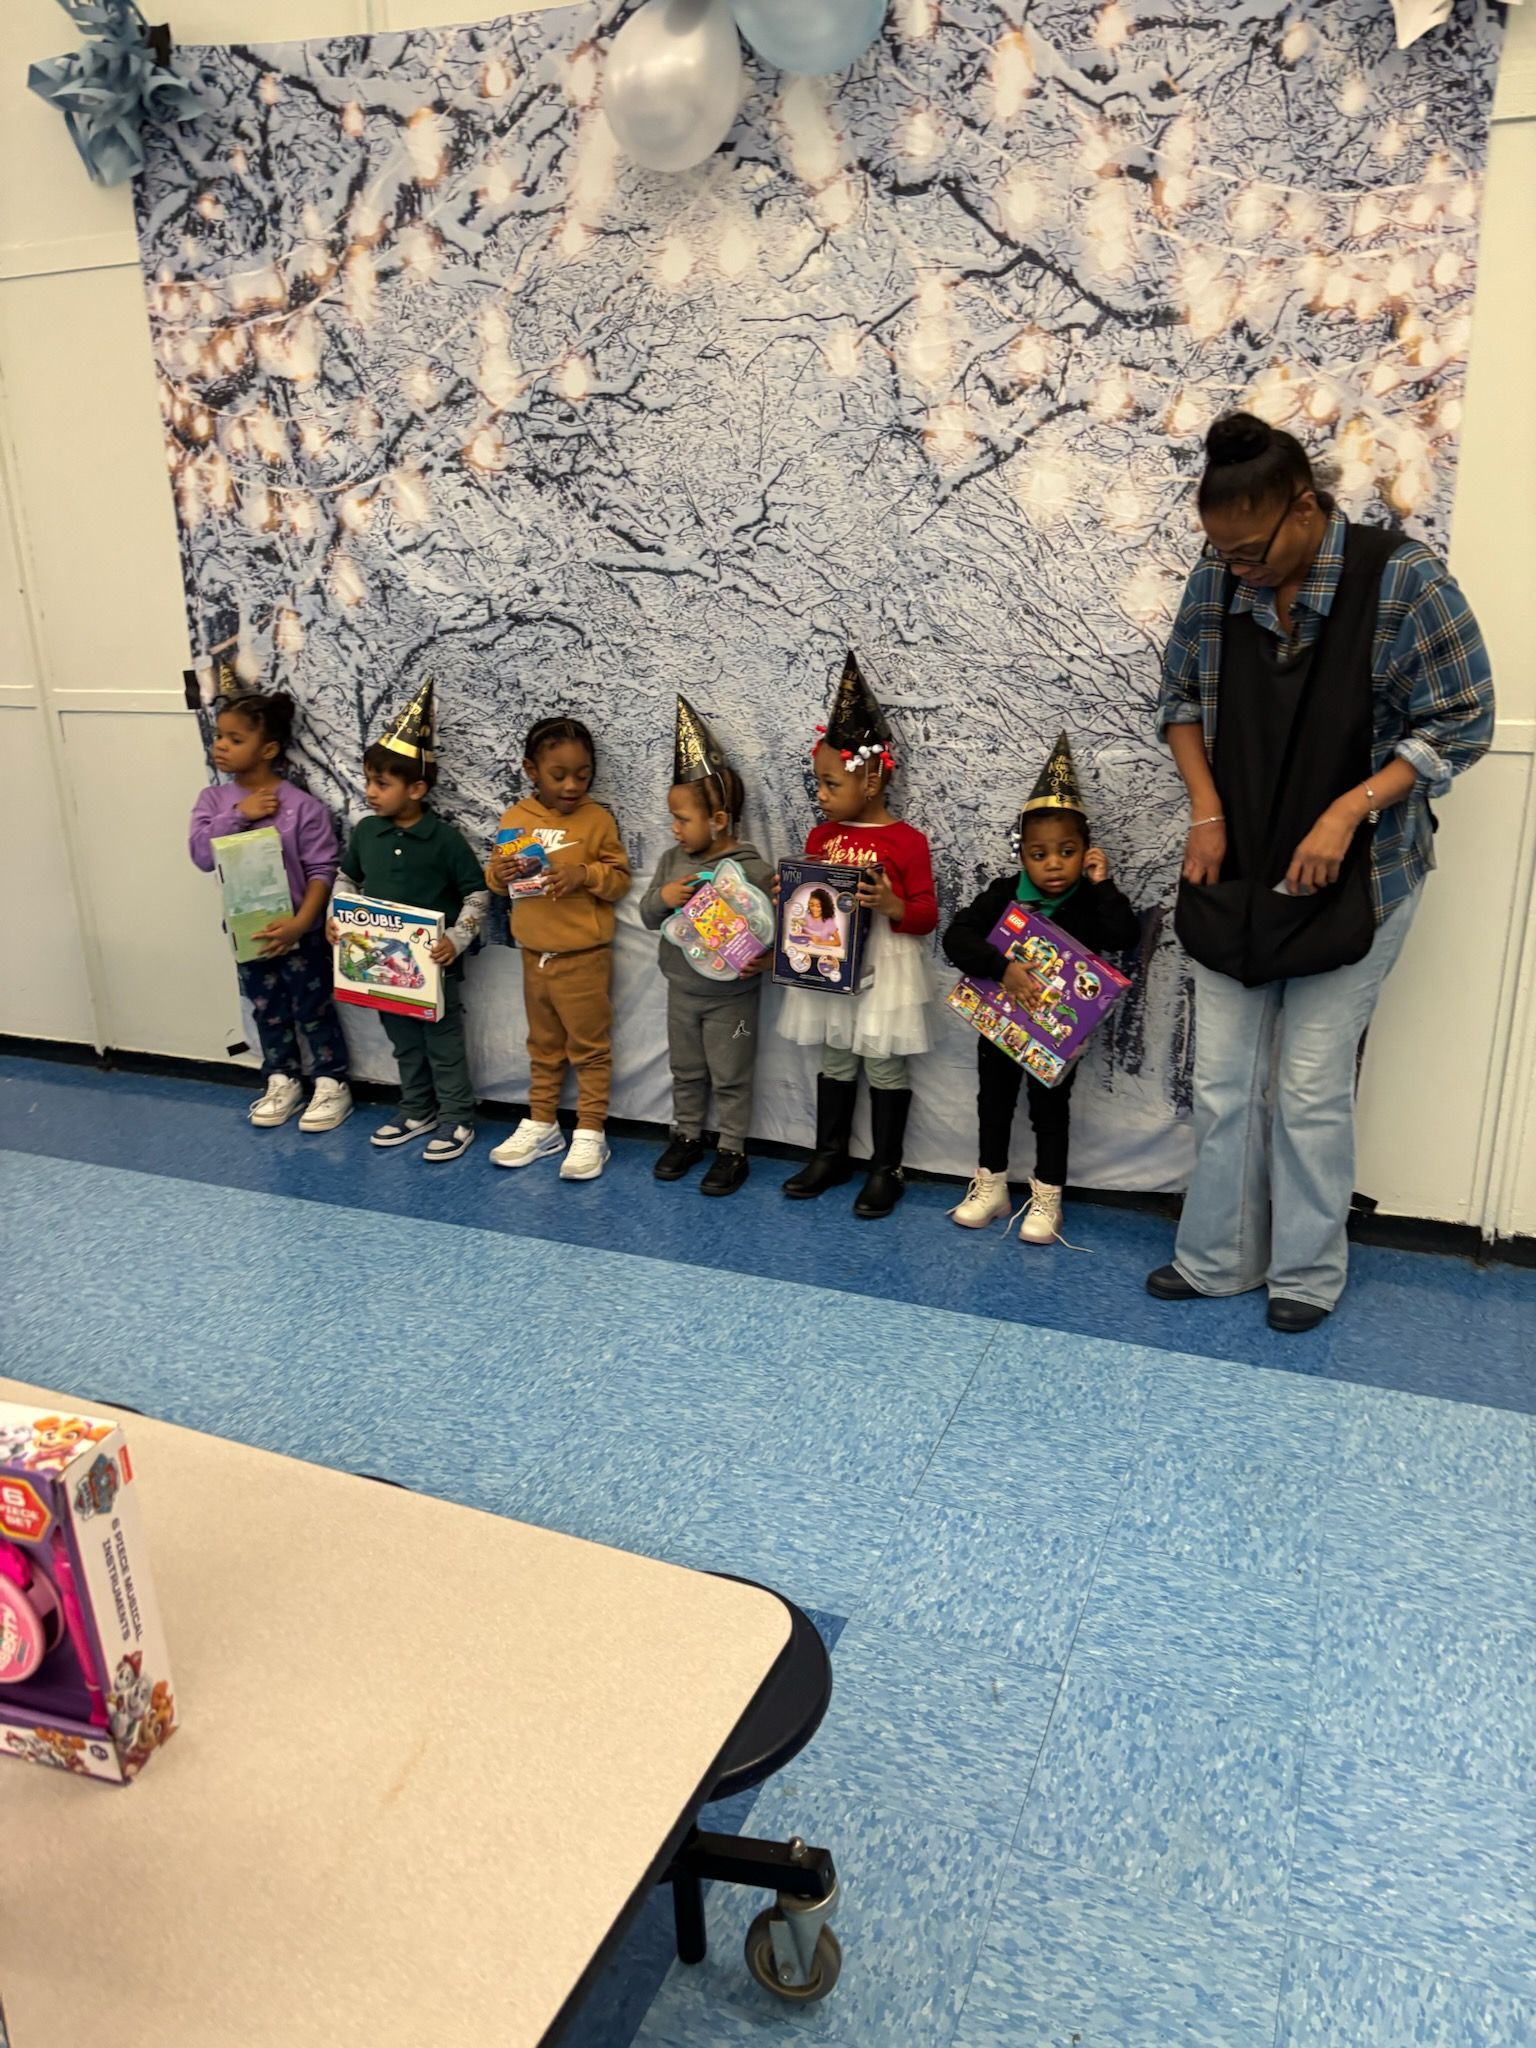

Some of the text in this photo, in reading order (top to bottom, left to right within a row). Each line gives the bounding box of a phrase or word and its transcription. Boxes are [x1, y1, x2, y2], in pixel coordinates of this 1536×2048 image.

[782, 869, 802, 885] WISH
[336, 908, 404, 929] TROUBLE
[1007, 913, 1027, 929] LEGO
[2, 1486, 26, 1508] 6
[5, 1514, 32, 1530] SET
[102, 1537, 131, 1642] INSTRUMENTS
[111, 1517, 144, 1643] 6 PIECE MUSICAL
